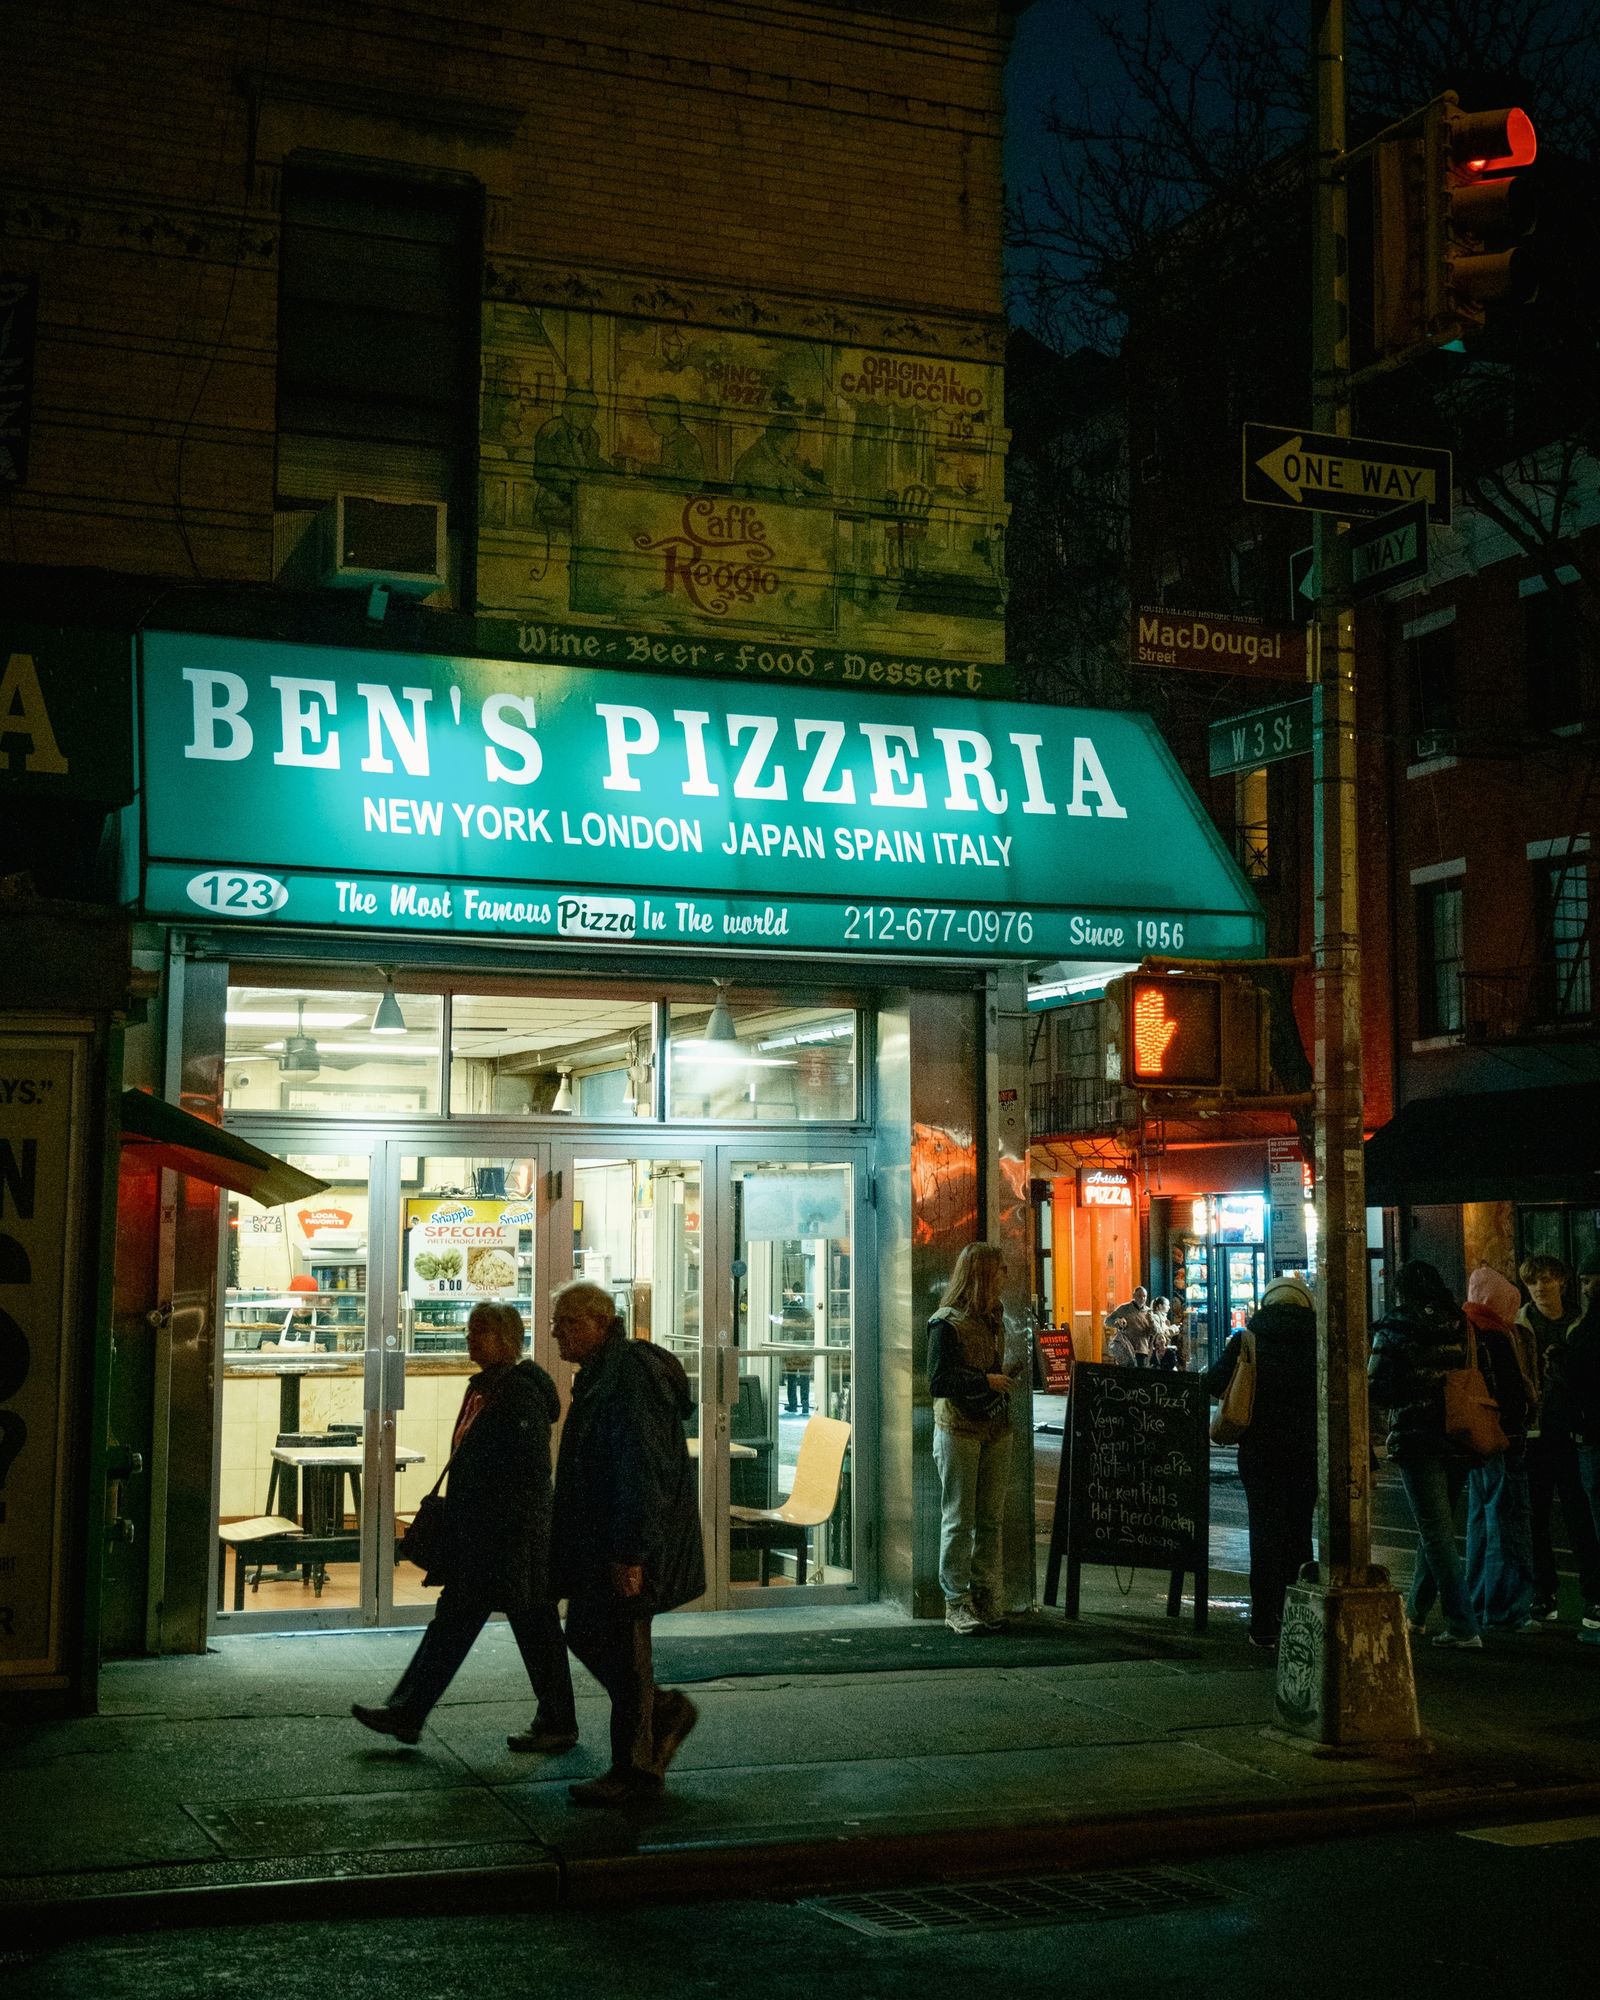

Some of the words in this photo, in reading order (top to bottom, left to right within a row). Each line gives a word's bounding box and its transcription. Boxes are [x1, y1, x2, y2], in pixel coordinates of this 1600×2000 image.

[709, 361, 774, 386] SINCE
[862, 356, 961, 386] ORIGINAL
[721, 383, 769, 405] 1927
[840, 372, 984, 408] CAPPUCCINO
[1283, 454, 1344, 489] ONE
[1361, 463, 1424, 498] WAY
[682, 496, 774, 555] Caffe
[1366, 529, 1408, 573] WAY
[634, 534, 779, 616] Reggio
[1165, 607, 1197, 618] VILLAGE
[1198, 610, 1231, 622] HISTORIC
[517, 622, 601, 656] Wine
[626, 635, 707, 667] Beer
[734, 645, 815, 676] Food
[842, 652, 983, 692] Dessert
[1138, 646, 1177, 664] Street
[1139, 617, 1281, 665] MacDougal
[182, 667, 544, 786] BEN'S
[595, 702, 1129, 820] PIZZERIA
[1231, 727, 1246, 763] W
[1253, 721, 1266, 758] 3
[1272, 714, 1294, 753] St
[363, 796, 444, 836] NEW
[451, 802, 553, 843] YORK
[561, 811, 703, 853] LONDON
[721, 822, 826, 859] JAPAN
[834, 827, 926, 864] SPAIN
[932, 832, 1012, 867] ITALY
[203, 875, 275, 909] 123
[335, 881, 378, 914] The
[390, 884, 452, 919] Most
[464, 889, 551, 923] Famous
[557, 900, 637, 933] Pizza
[643, 900, 667, 930] In
[675, 902, 714, 933] The
[723, 908, 789, 936] world
[843, 906, 1033, 943] 212-677-0976
[1069, 916, 1125, 947] Since
[1136, 920, 1185, 949] 1956
[1087, 1171, 1128, 1184] Artistic
[1272, 1163, 1279, 1173] 3
[1085, 1186, 1132, 1206] PIZZA
[252, 1216, 281, 1224] PZZA
[253, 1224, 283, 1233] SNB
[431, 1207, 474, 1224] Snapple
[500, 1209, 533, 1224] Snapp
[425, 1226, 507, 1238] SPECIAL
[1090, 1408, 1124, 1438] Vegan
[1128, 1406, 1166, 1434] Slice
[1091, 1431, 1129, 1464] Vegan
[1088, 1478, 1138, 1506] Chicken
[1091, 1502, 1118, 1523] Hot
